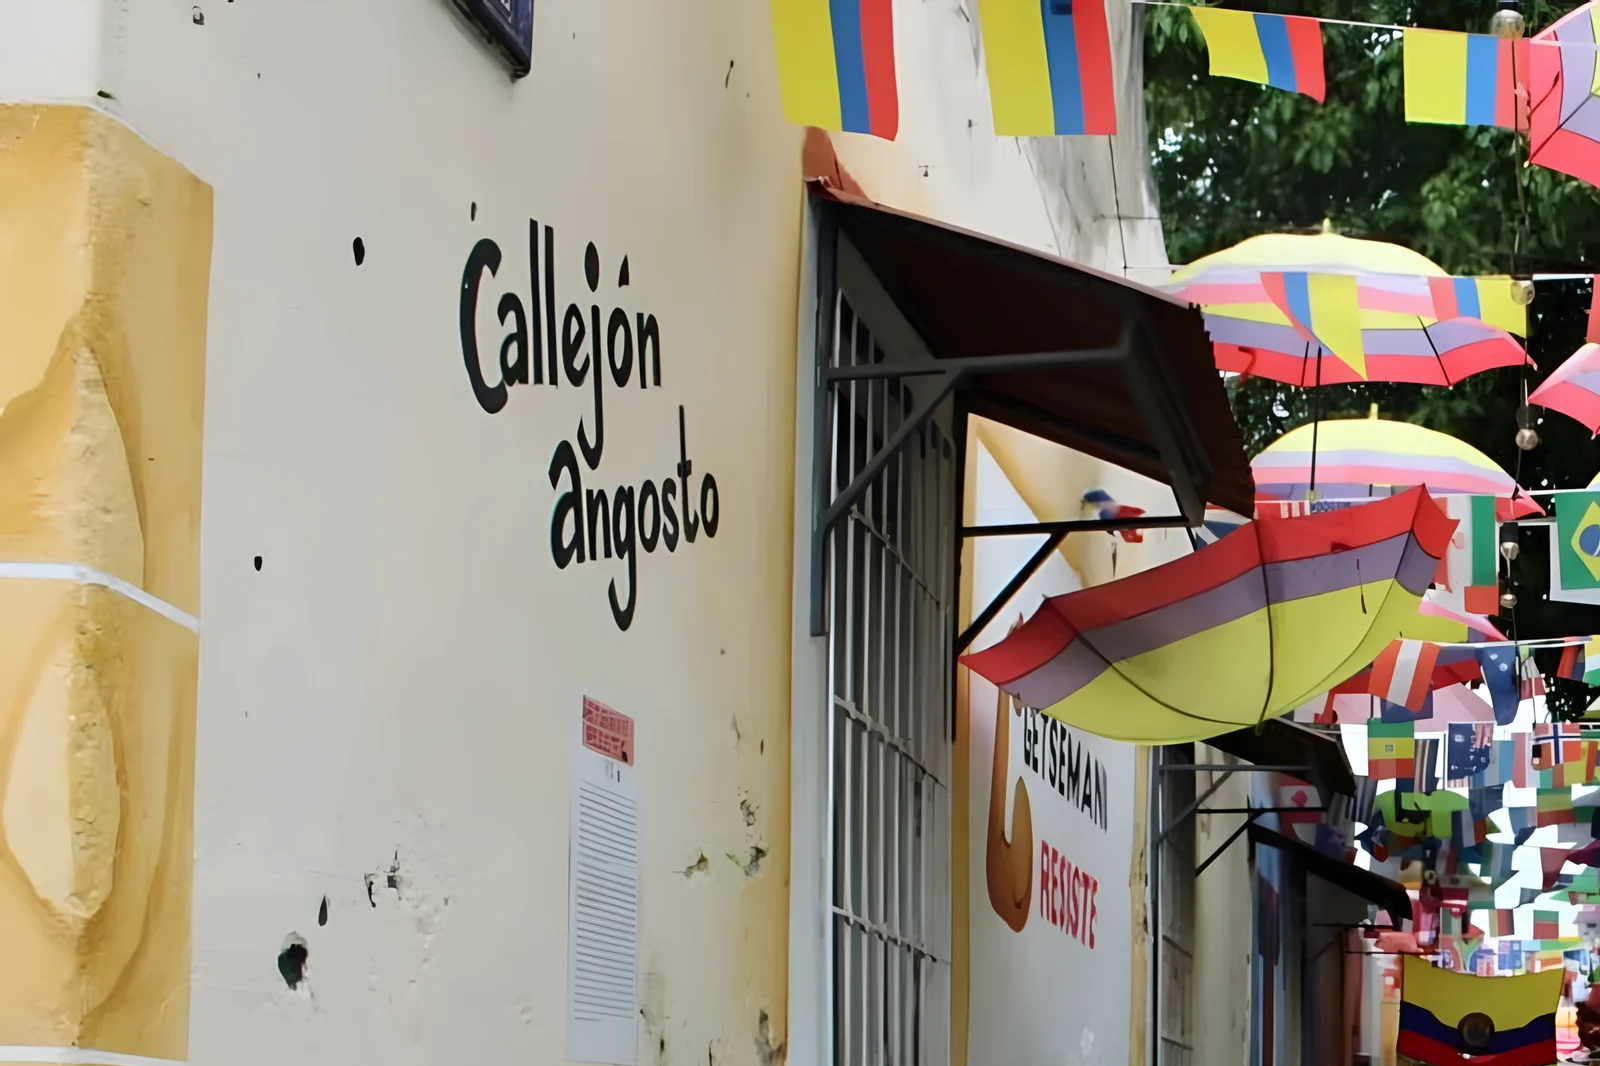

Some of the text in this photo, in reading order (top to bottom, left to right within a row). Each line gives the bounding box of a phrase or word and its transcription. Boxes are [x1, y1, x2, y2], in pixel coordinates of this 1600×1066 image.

[460, 217, 662, 471] Callejón
[548, 405, 720, 632] angosto
[1040, 839, 1098, 950] RESISTE
